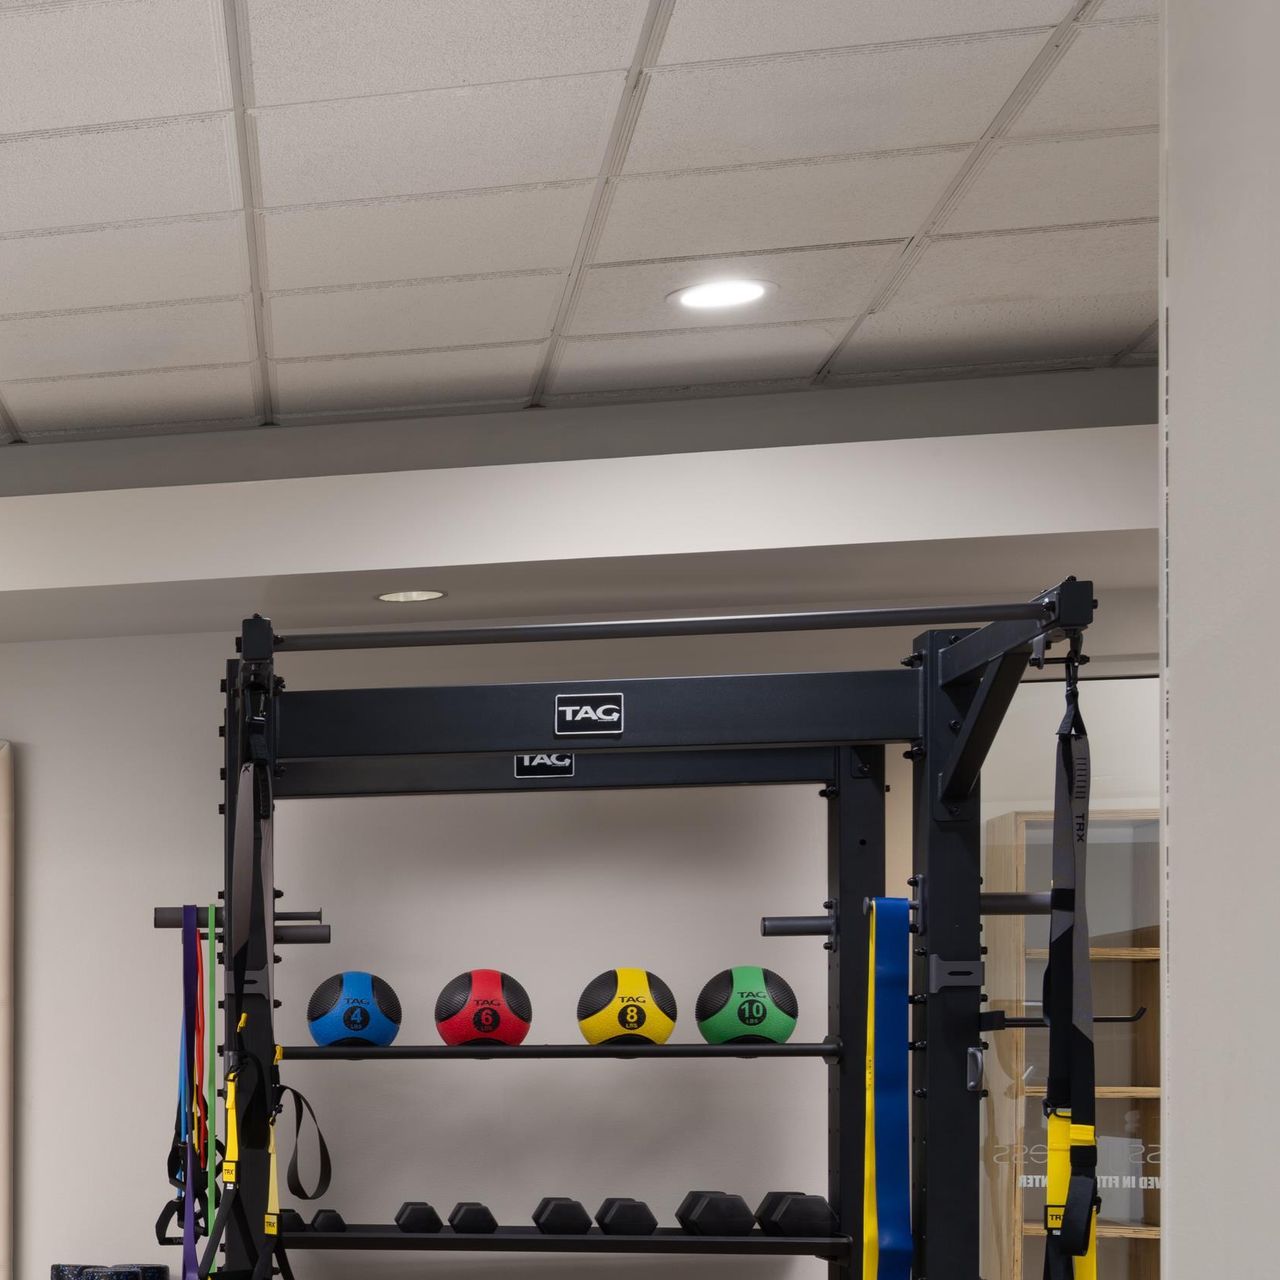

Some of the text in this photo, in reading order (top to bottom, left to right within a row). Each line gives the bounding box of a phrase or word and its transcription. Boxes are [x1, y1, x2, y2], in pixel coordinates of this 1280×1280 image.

[558, 704, 620, 722] TAG
[517, 753, 571, 767] TAG
[1075, 813, 1085, 842] TRX
[343, 997, 370, 1006] TAG
[618, 996, 646, 1004] TAG
[350, 1006, 362, 1022] 4
[481, 1007, 493, 1025] 6
[626, 1006, 638, 1022] 8
[741, 1002, 762, 1018] 10
